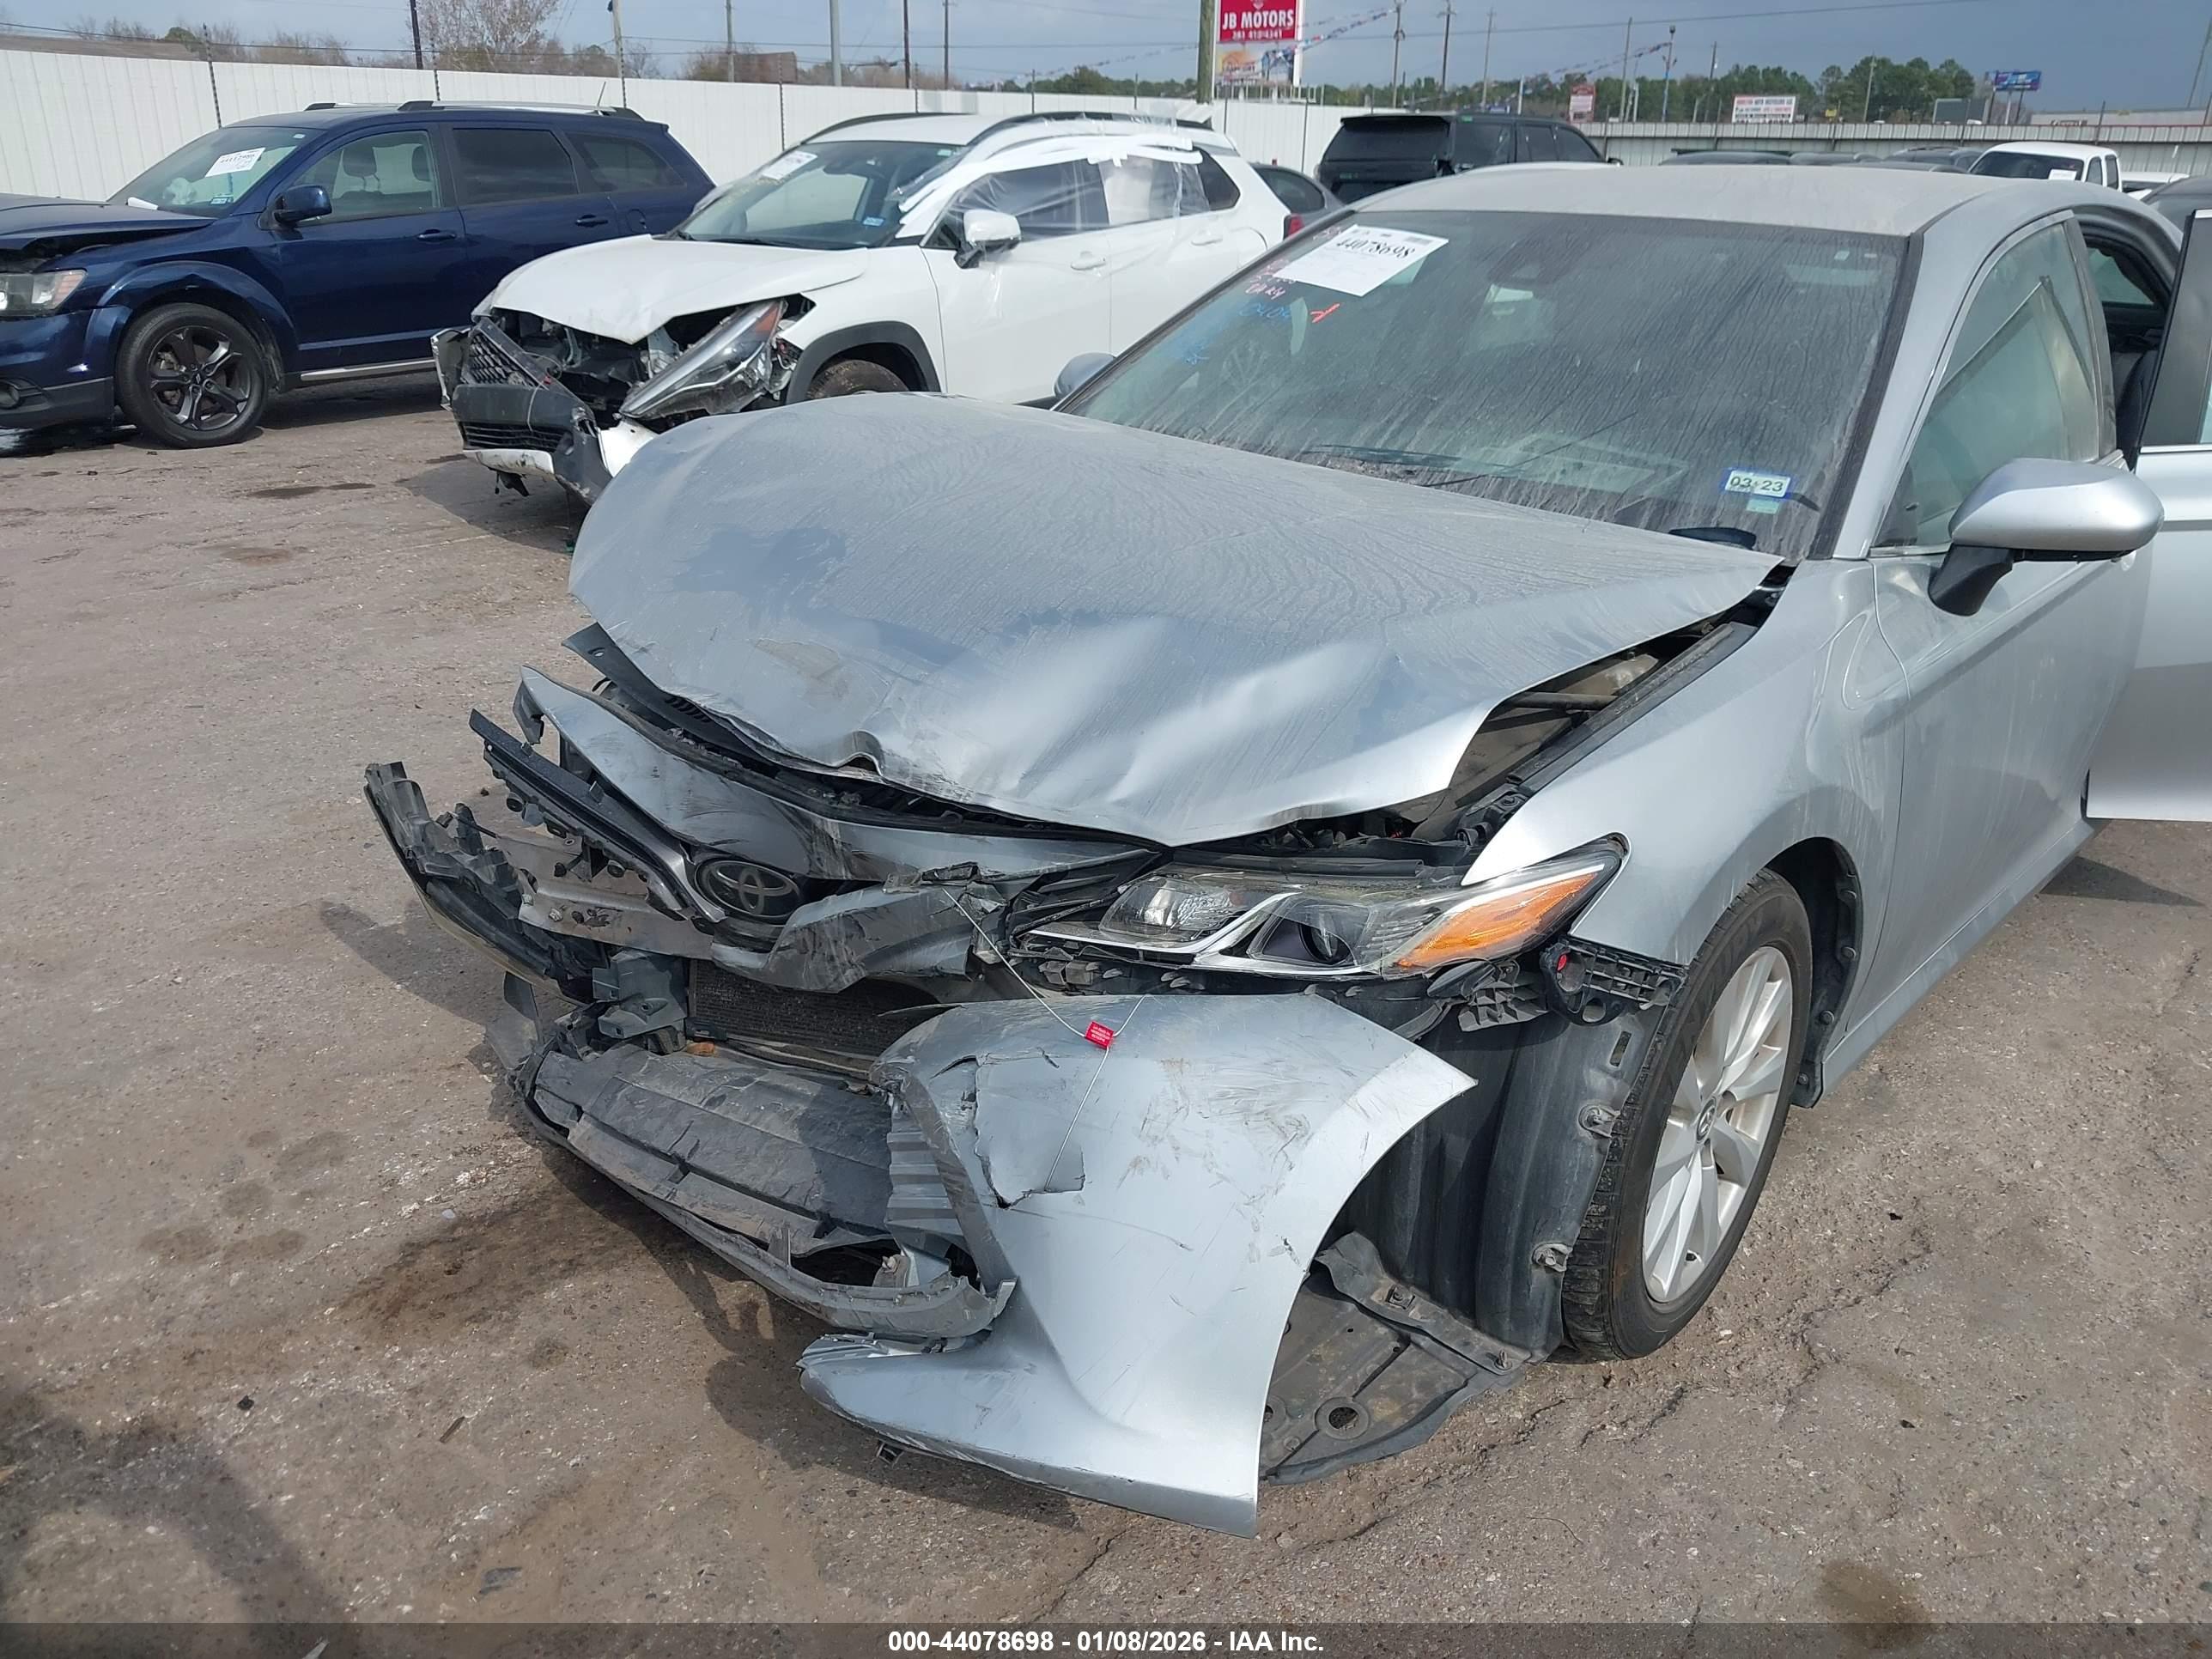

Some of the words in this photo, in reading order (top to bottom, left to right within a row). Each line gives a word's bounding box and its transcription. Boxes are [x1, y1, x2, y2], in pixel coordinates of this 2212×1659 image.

[1222, 12, 1237, 30] JB
[1241, 9, 1294, 28] MOTORS
[1730, 477, 1752, 488] 03
[1760, 480, 1784, 492] 23
